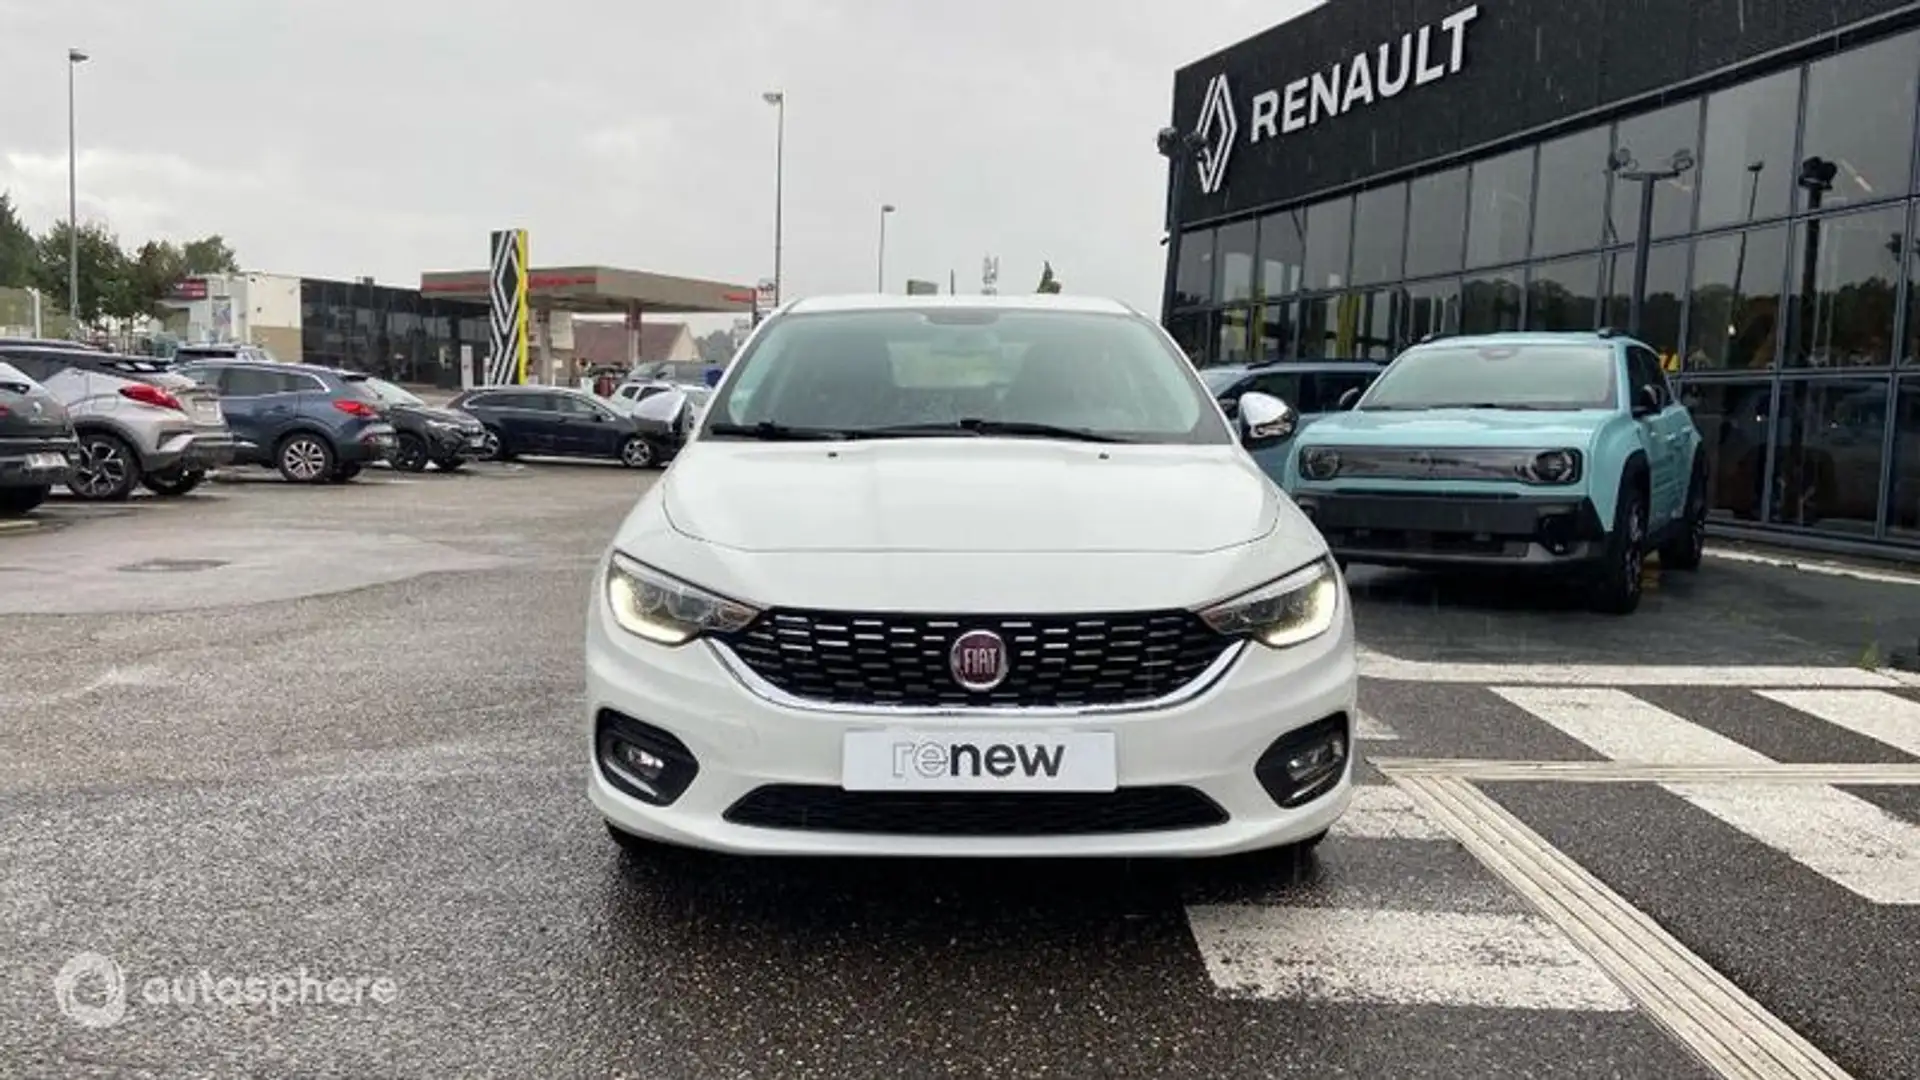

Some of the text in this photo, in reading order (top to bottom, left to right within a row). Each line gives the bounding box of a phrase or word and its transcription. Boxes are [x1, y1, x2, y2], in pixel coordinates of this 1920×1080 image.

[1251, 4, 1478, 144] RENAULT
[964, 648, 997, 674] FIAT
[893, 742, 1066, 779] renew
